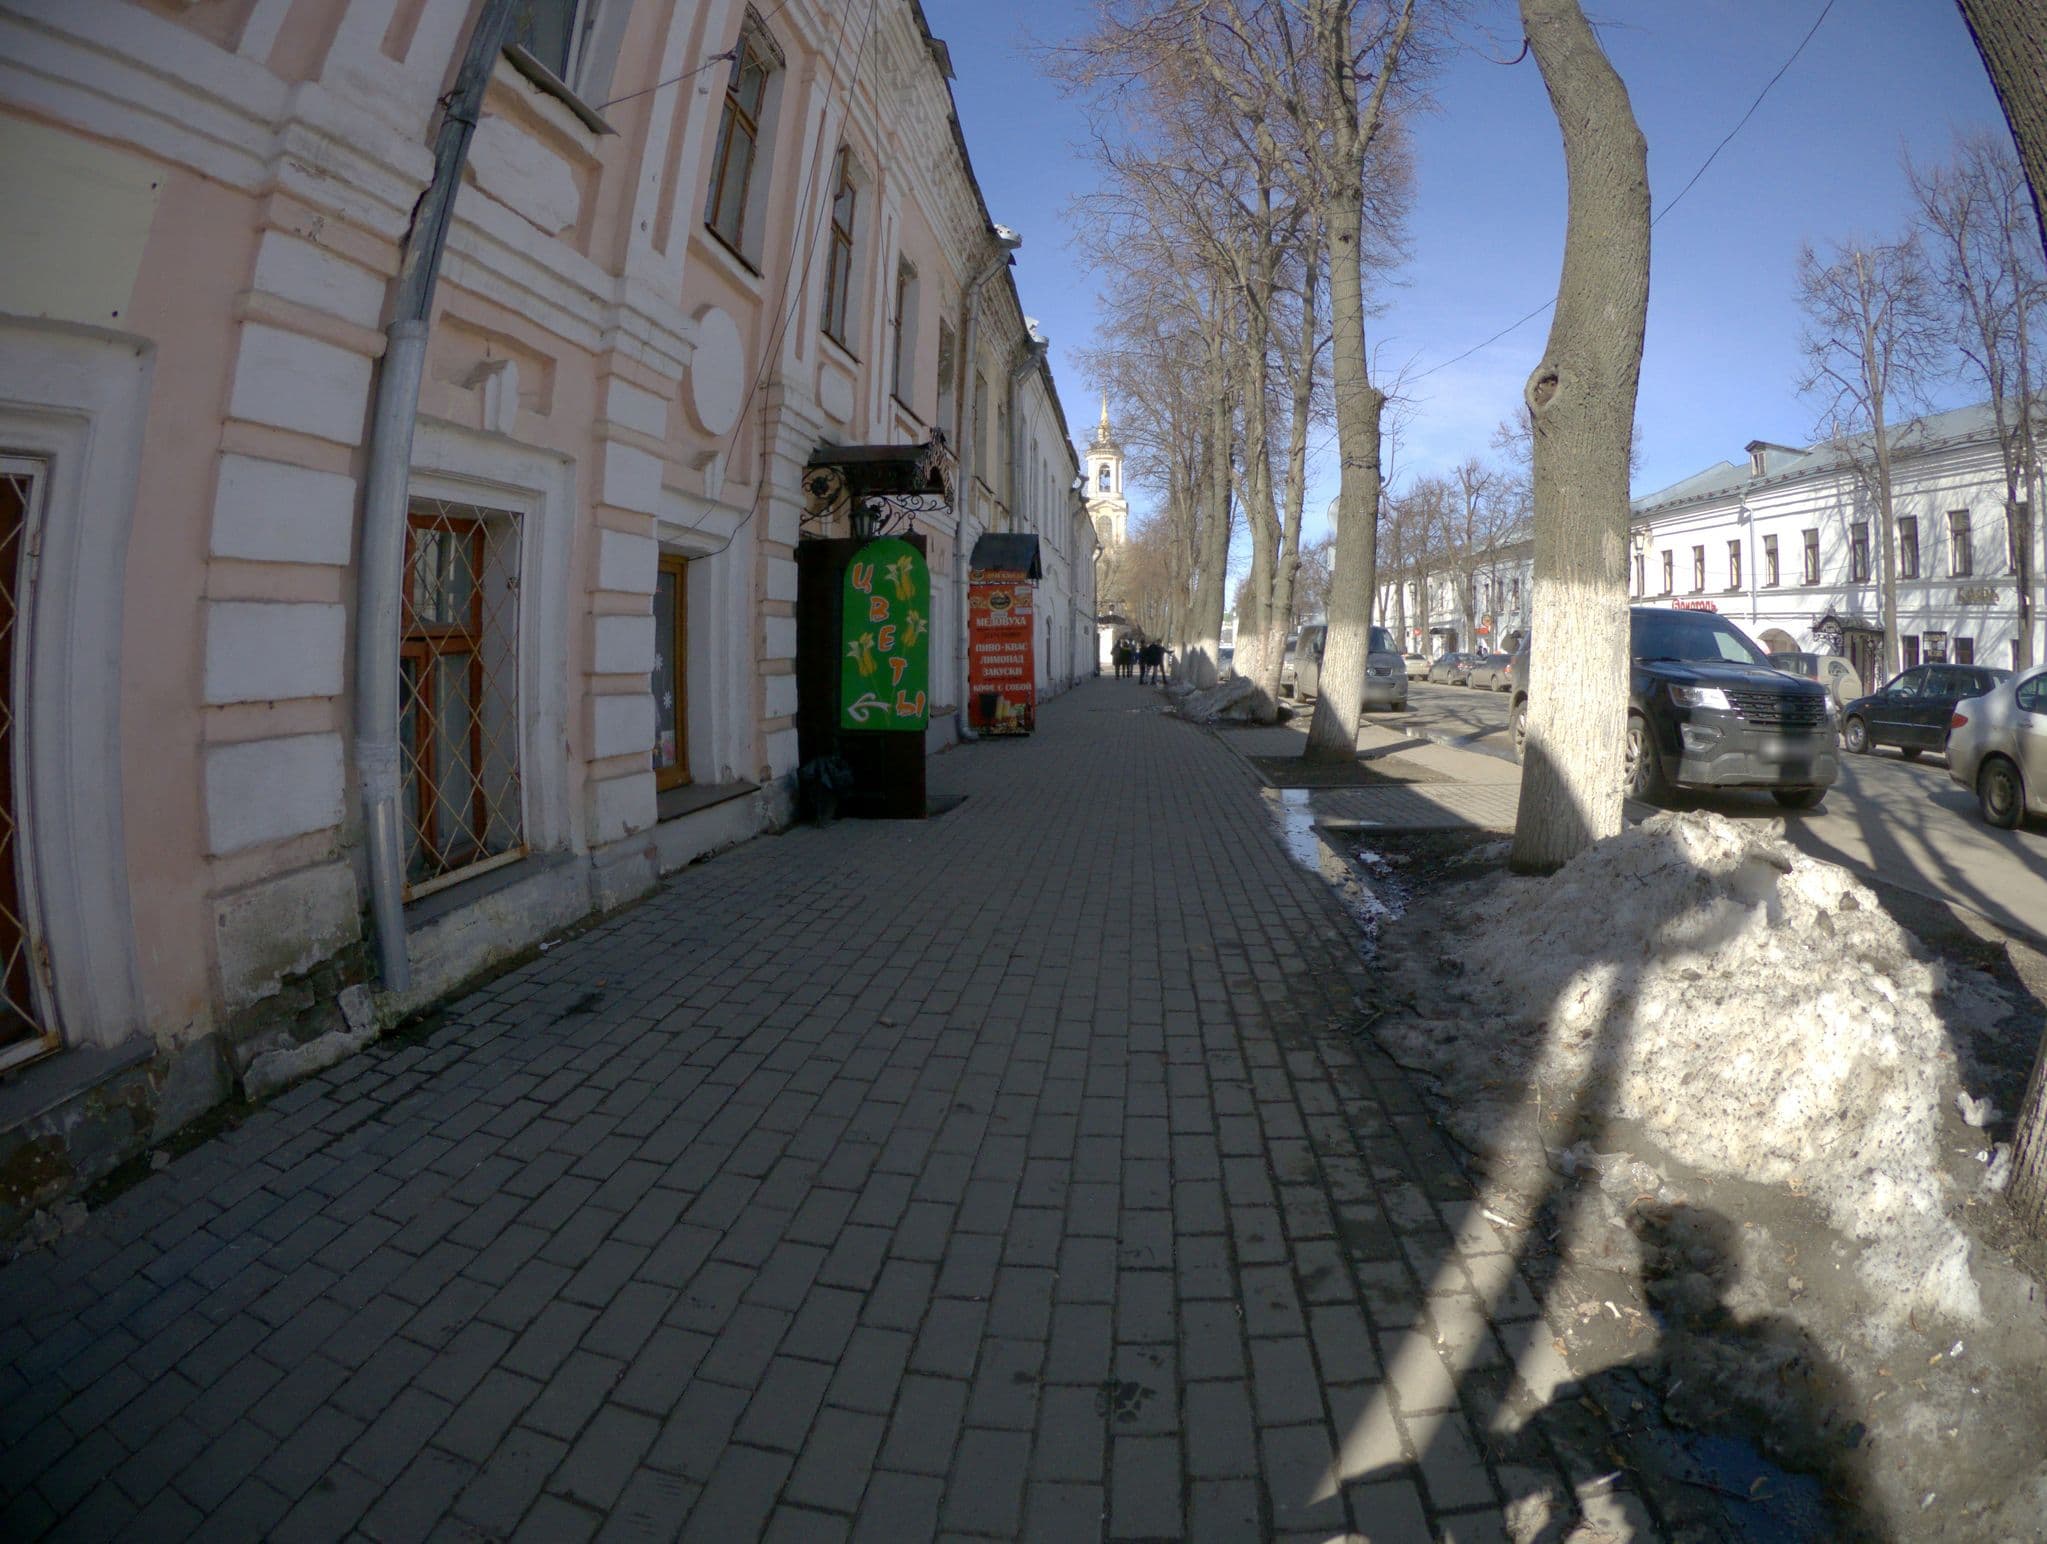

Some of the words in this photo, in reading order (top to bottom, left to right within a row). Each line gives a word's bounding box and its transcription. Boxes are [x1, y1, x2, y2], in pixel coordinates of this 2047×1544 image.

[976, 616, 1026, 627] МЕДОВУХА
[852, 562, 927, 718] ЦВЕТЫ
[979, 655, 1024, 665] ЛИМОНАД
[983, 667, 1023, 676] ЗАКУСКИ
